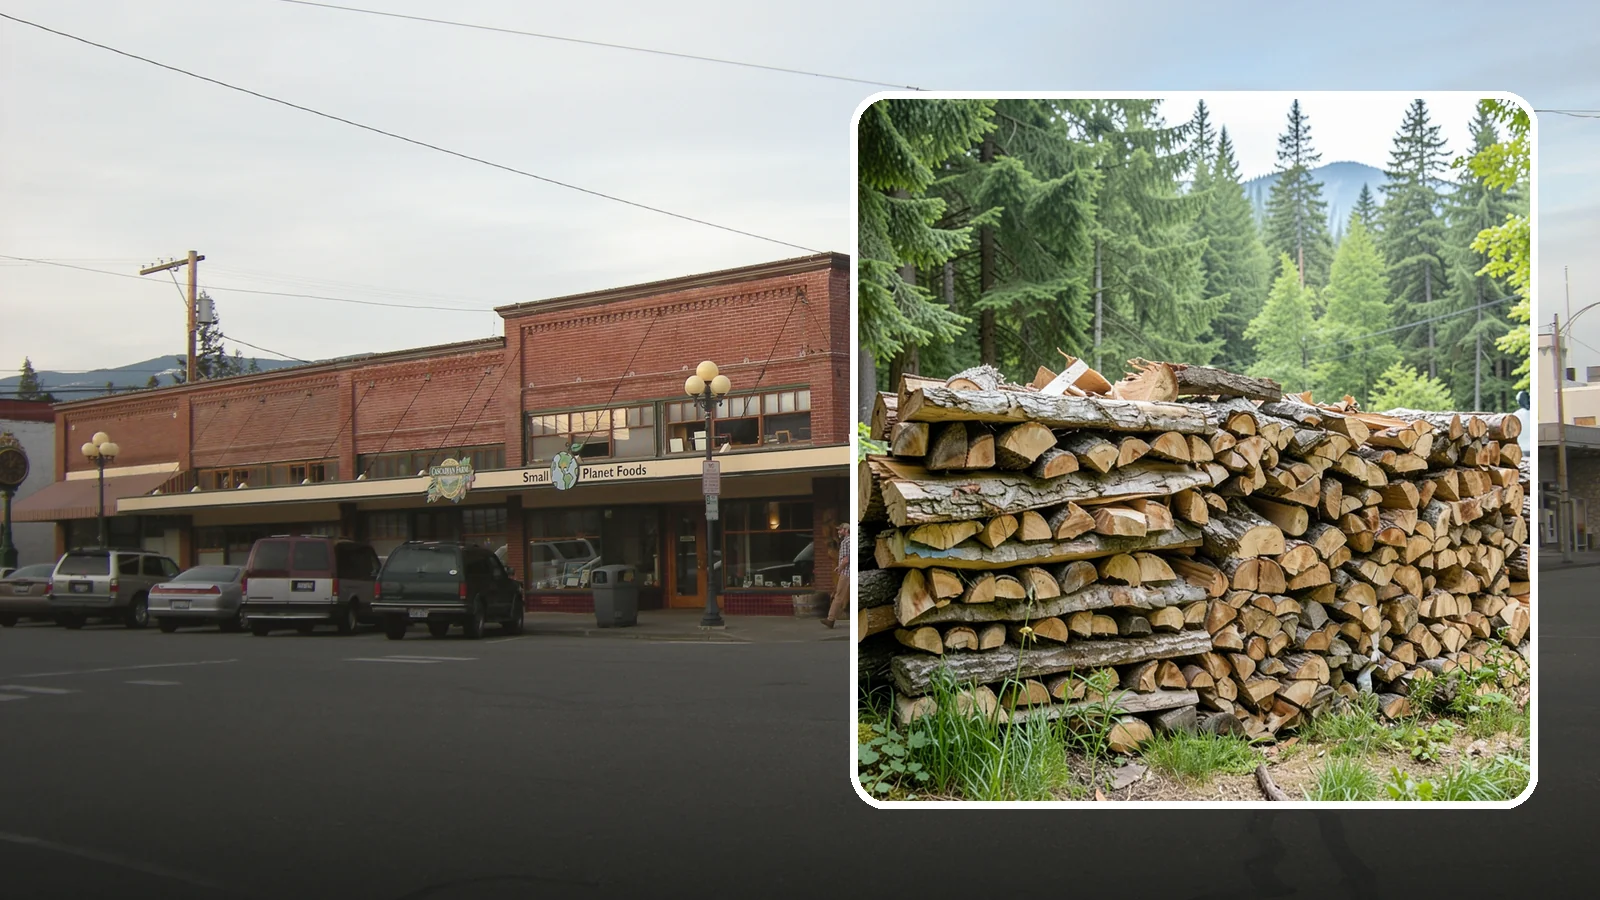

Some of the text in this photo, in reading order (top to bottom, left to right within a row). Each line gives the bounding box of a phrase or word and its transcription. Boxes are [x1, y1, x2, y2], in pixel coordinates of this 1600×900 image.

[523, 464, 647, 483] Small Planet Foods
